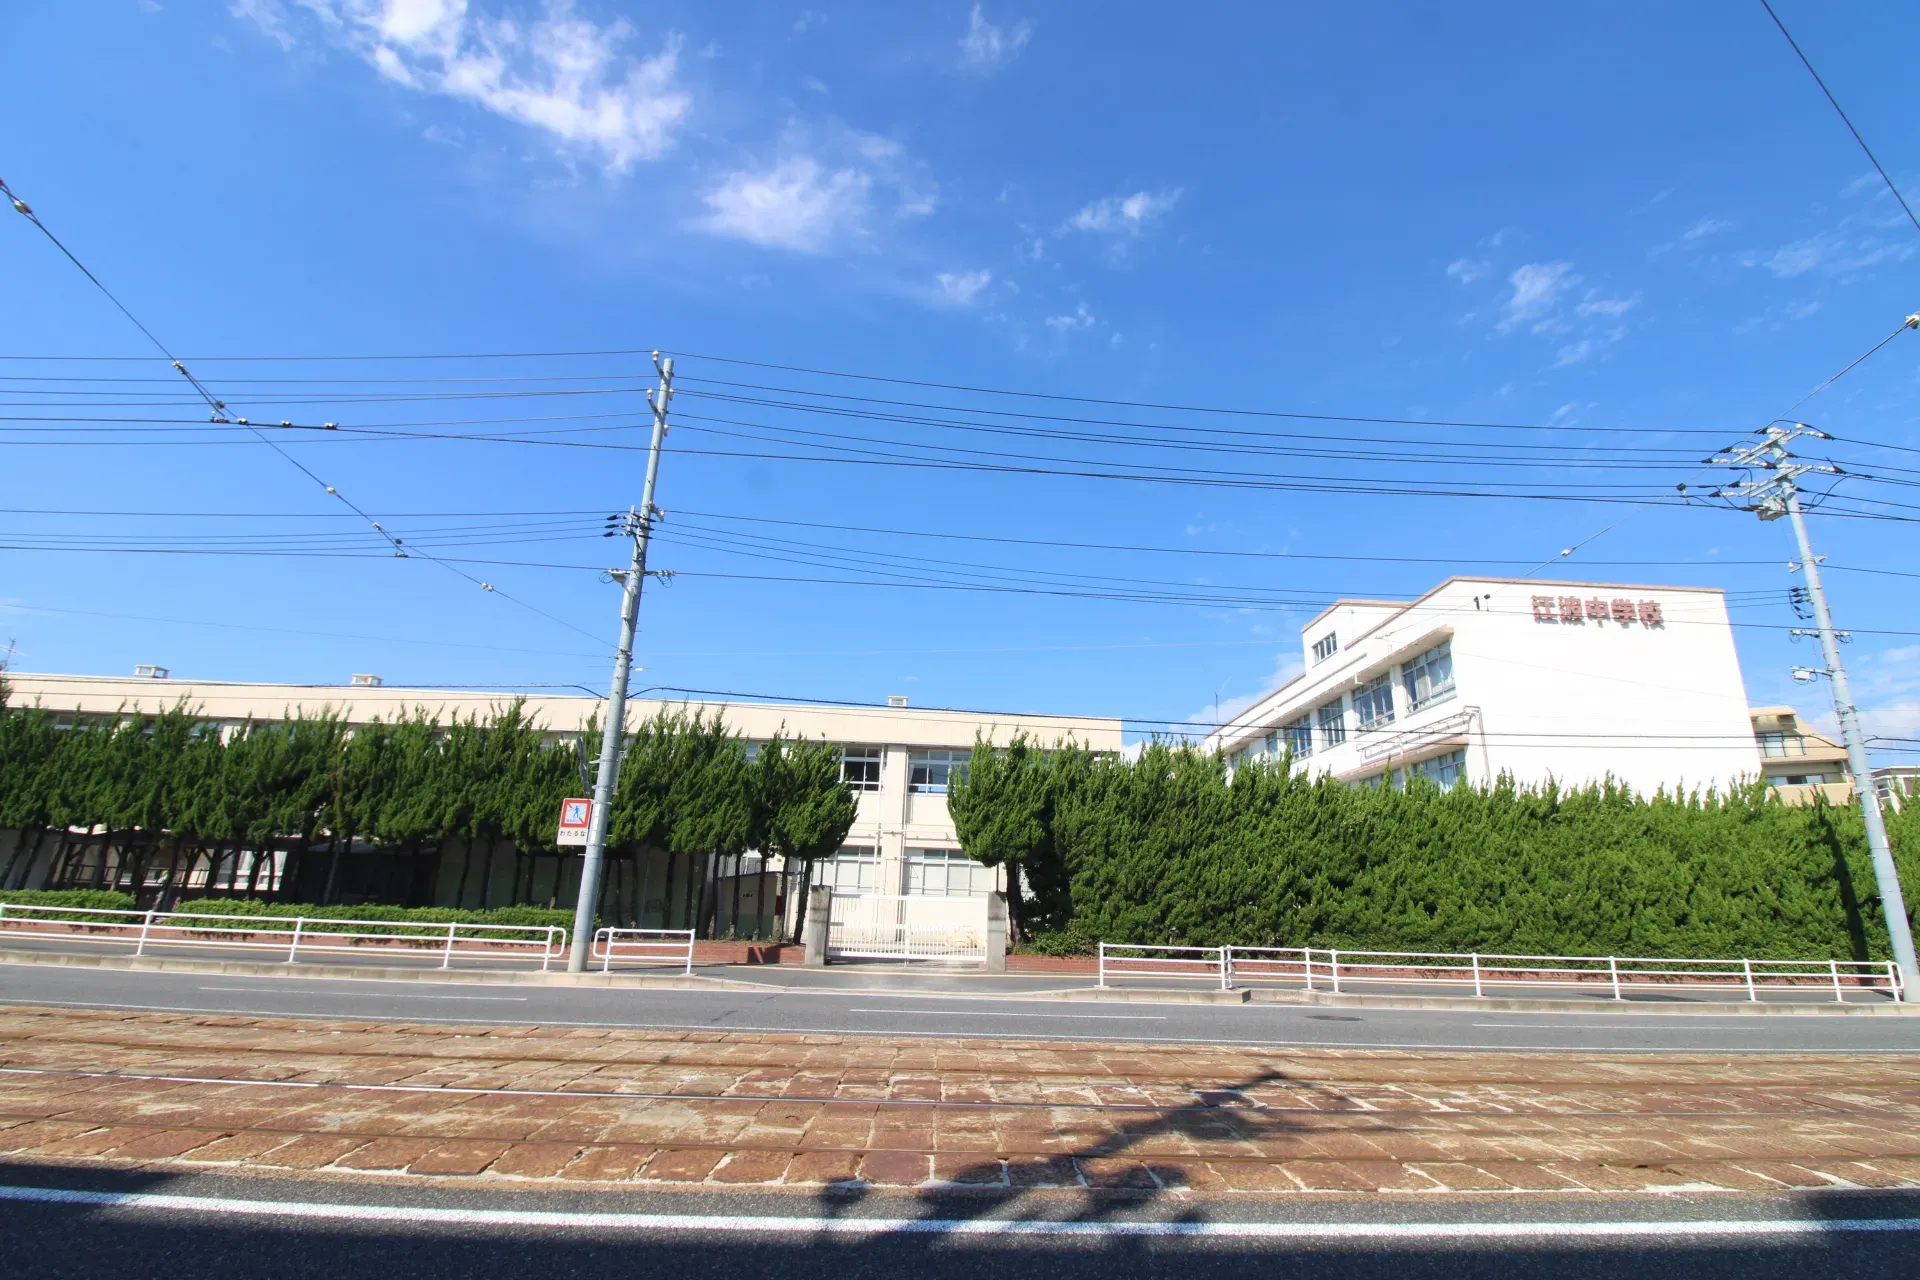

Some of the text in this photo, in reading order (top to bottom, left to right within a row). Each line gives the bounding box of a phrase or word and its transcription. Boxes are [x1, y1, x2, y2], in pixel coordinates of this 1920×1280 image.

[1531, 595, 1665, 628] 江波中学校
